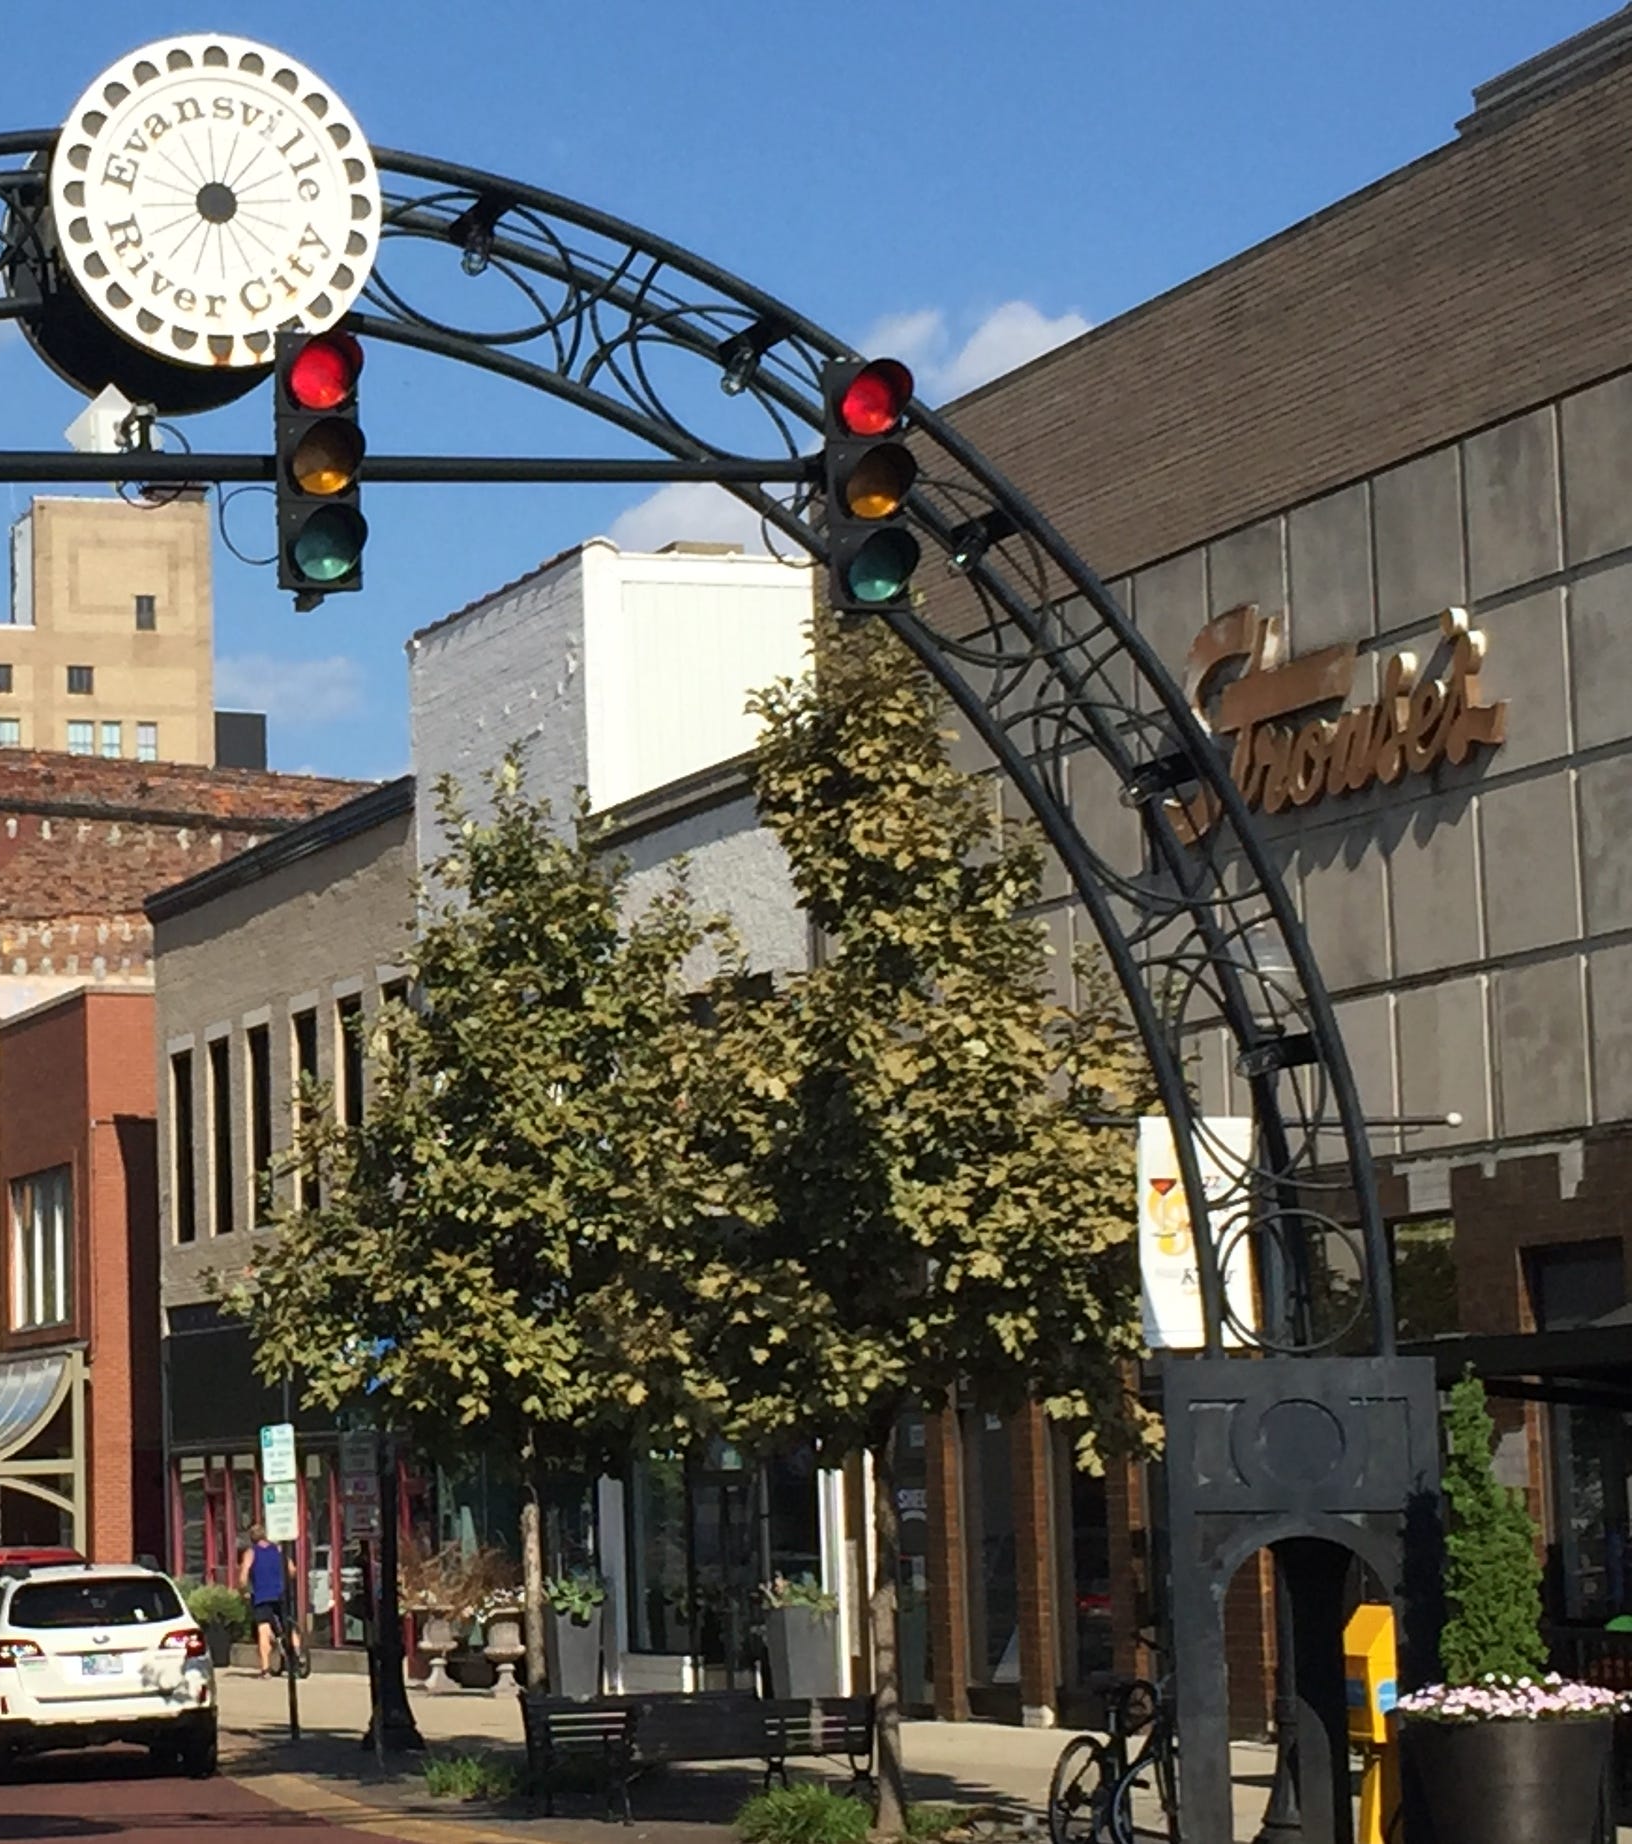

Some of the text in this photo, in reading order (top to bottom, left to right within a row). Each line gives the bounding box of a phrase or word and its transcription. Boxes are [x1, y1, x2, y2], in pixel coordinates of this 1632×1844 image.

[100, 95, 321, 203] Evansville
[104, 212, 332, 319] River City
